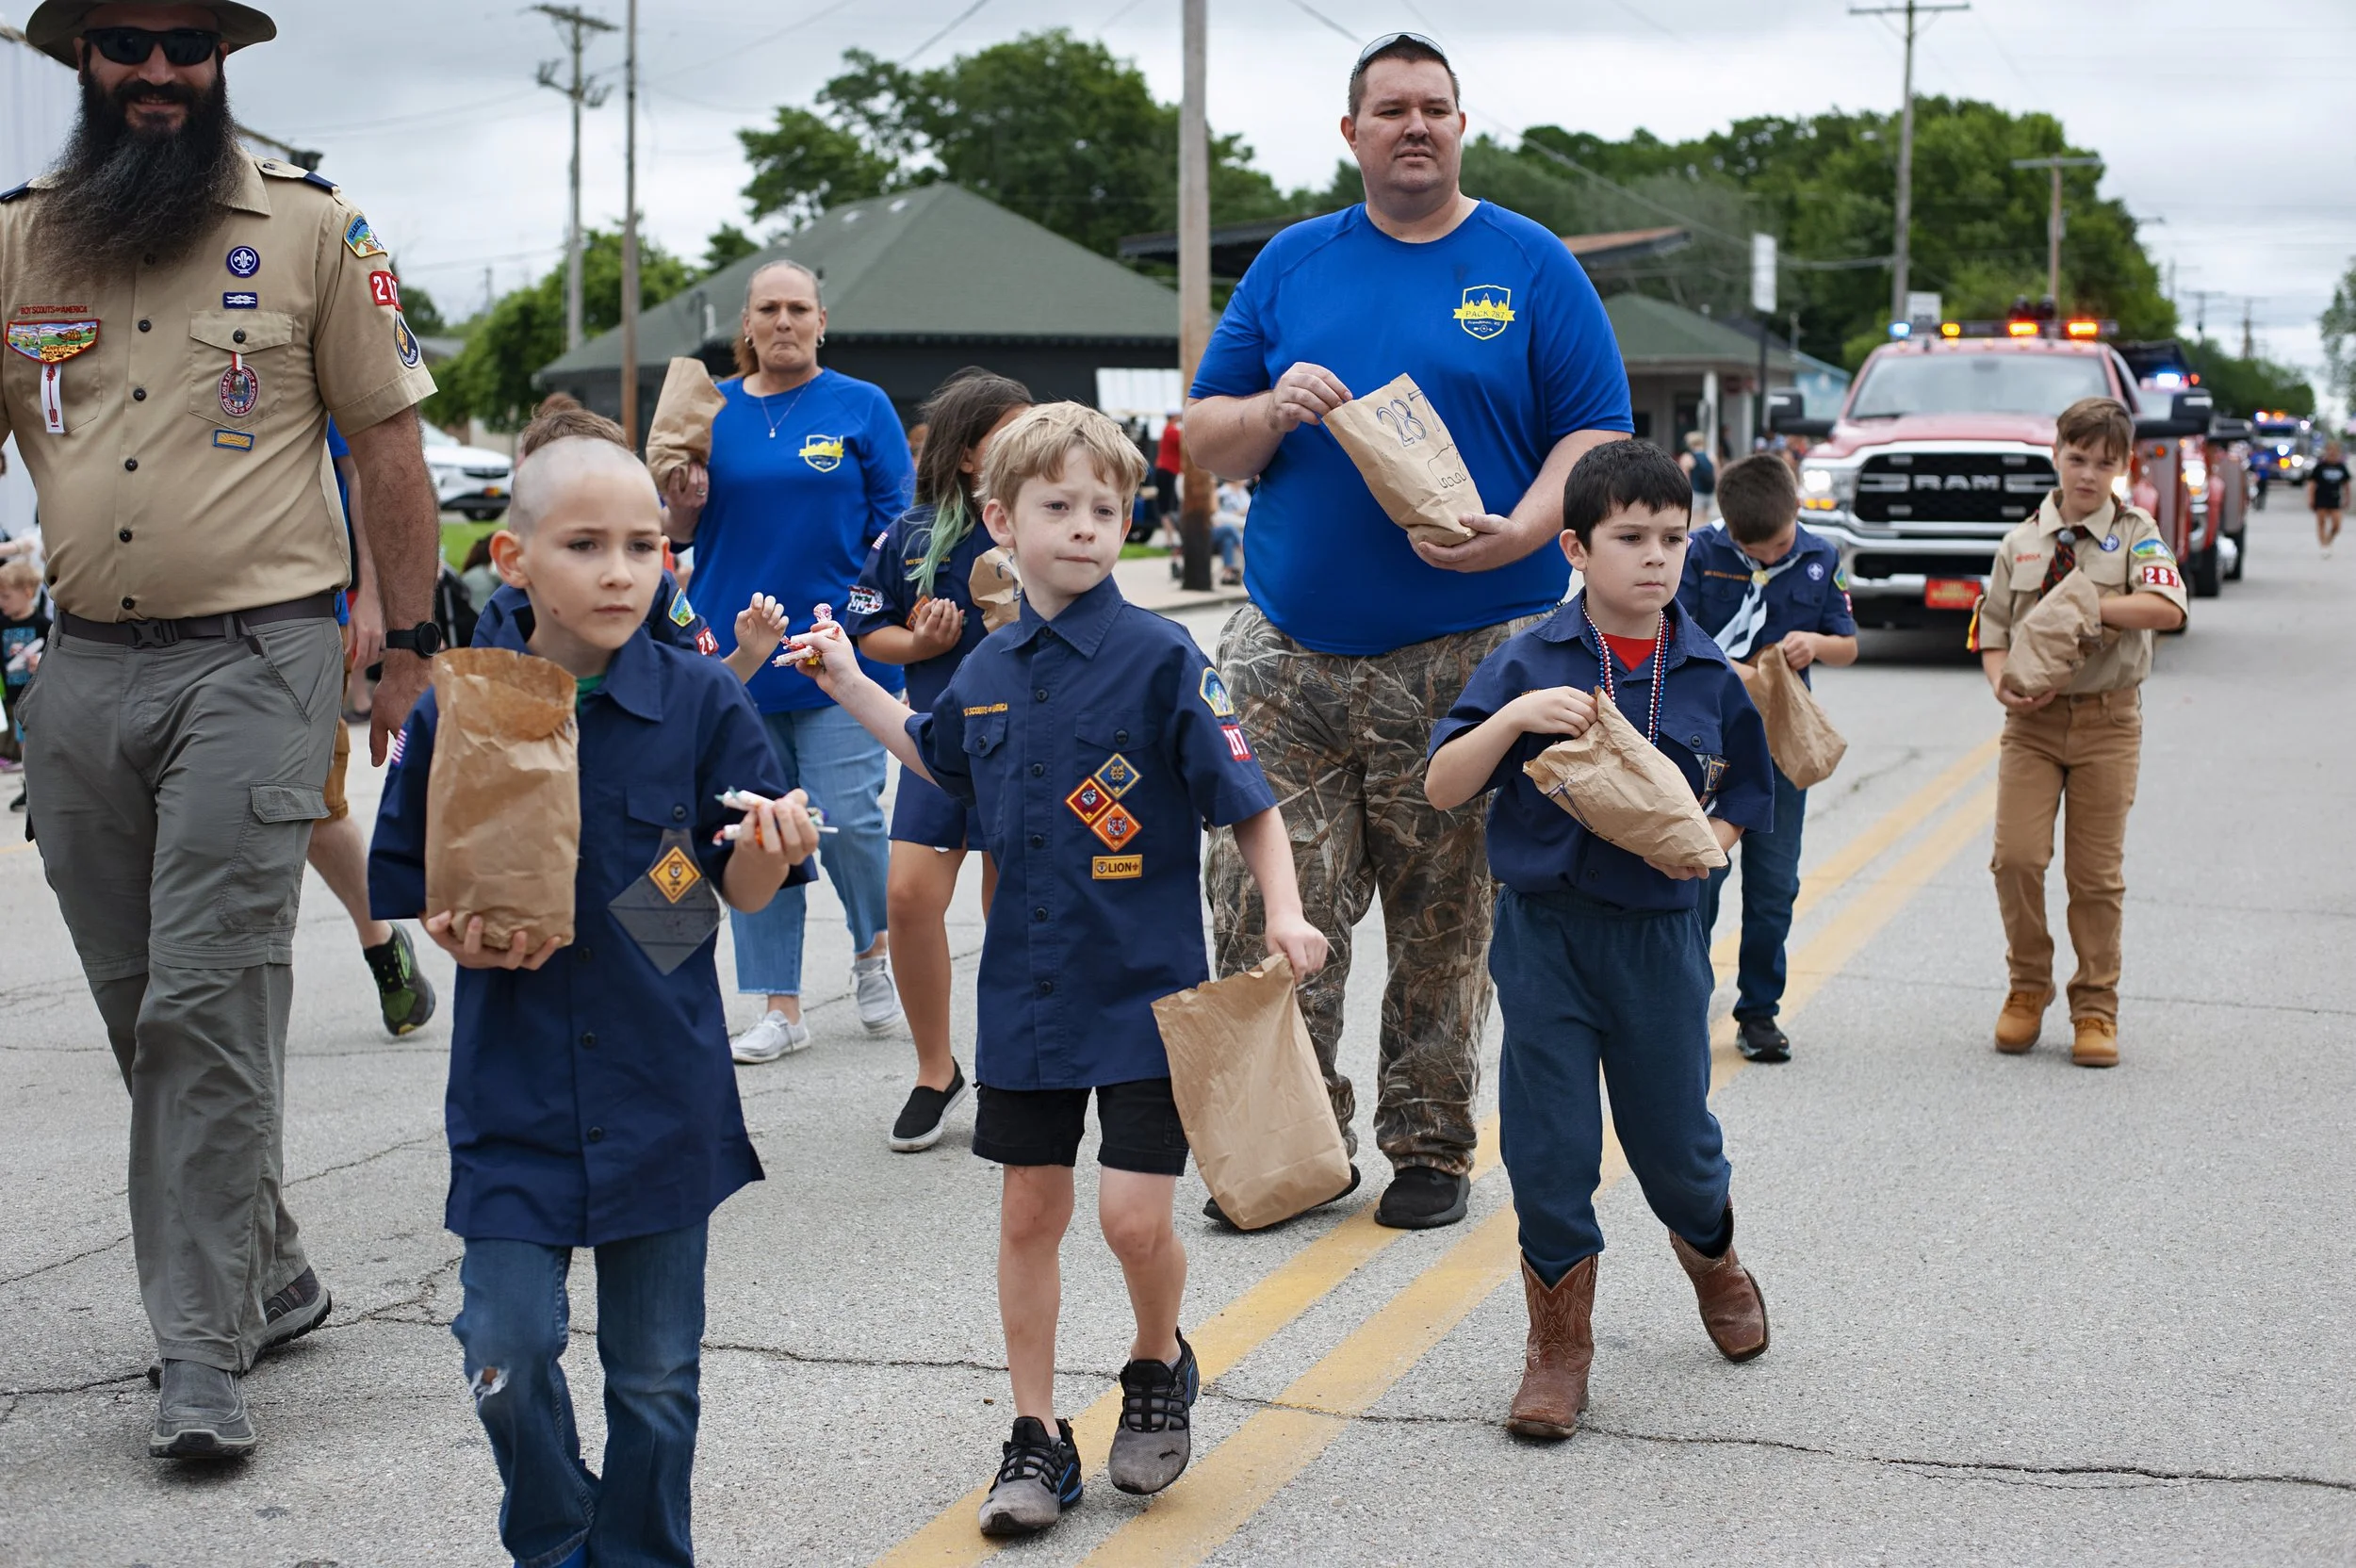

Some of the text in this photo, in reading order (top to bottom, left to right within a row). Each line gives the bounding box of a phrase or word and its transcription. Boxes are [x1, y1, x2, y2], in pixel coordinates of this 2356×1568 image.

[21, 306, 31, 315] BOY
[31, 305, 55, 314] SCOUTS
[61, 305, 88, 314] AMERICA
[1913, 474, 2001, 490] RAM
[2144, 567, 2179, 585] 287
[698, 630, 718, 655] 28
[1108, 861, 1132, 873] LION
